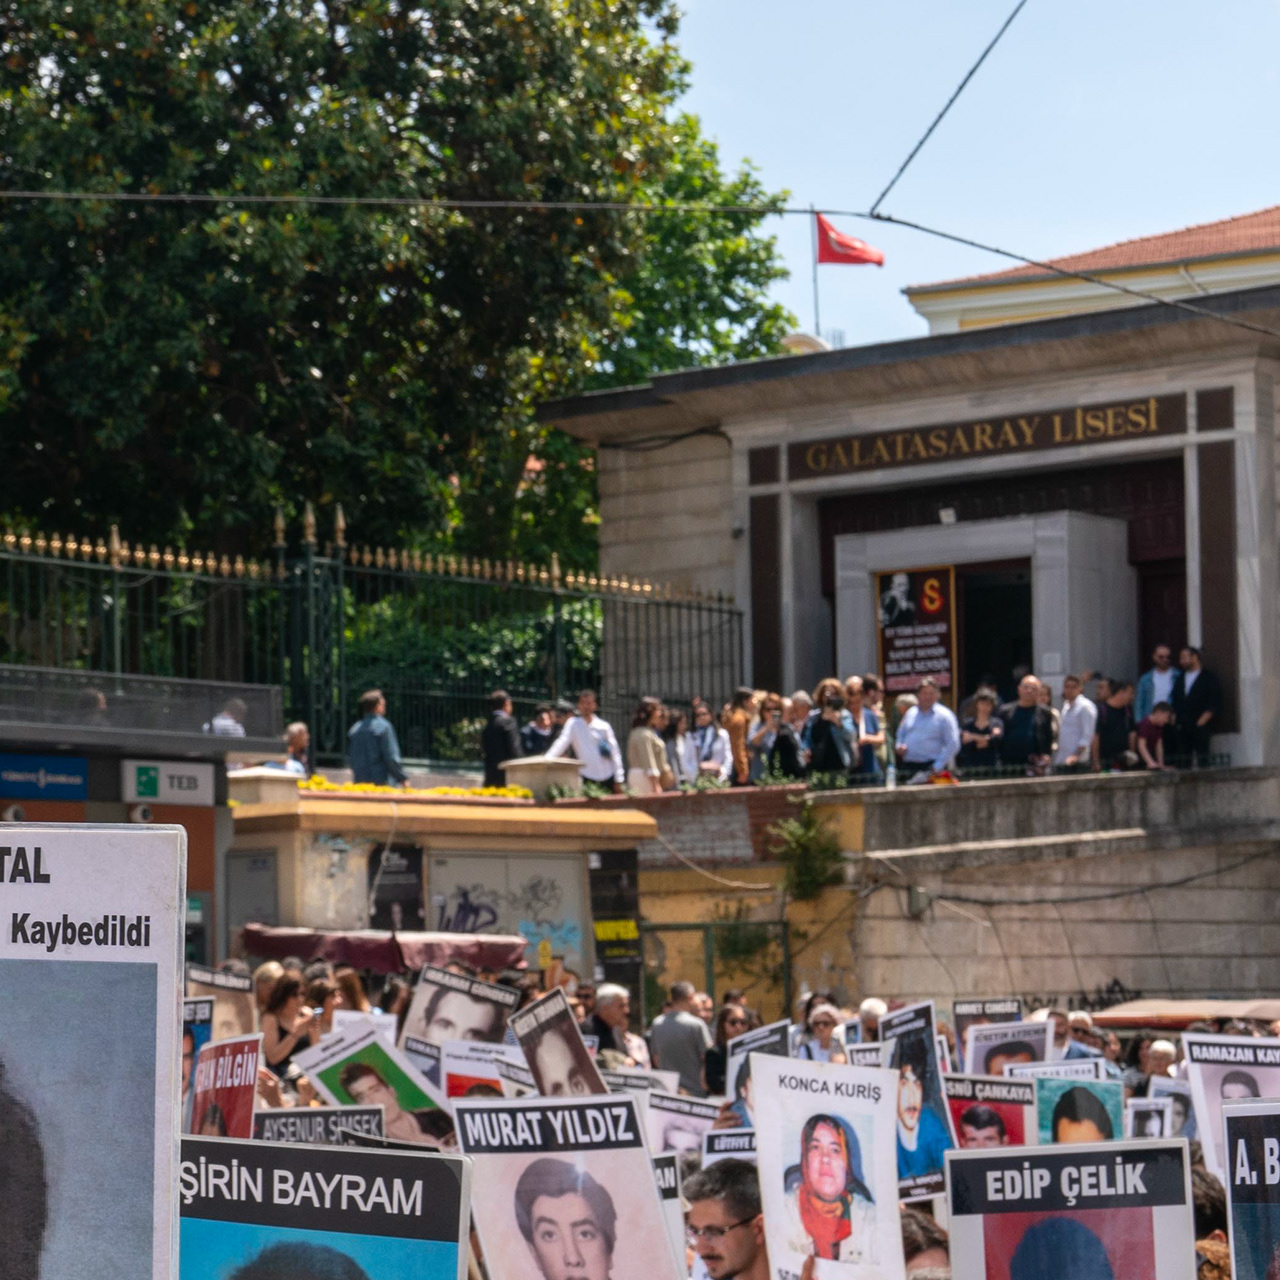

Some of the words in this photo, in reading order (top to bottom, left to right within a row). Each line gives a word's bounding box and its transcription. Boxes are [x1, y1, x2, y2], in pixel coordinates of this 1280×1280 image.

[806, 417, 1038, 472] GALATASARAY
[1053, 397, 1159, 442] LİSESİ
[167, 774, 199, 791] TEB
[11, 912, 152, 954] Kaybedildi
[217, 1046, 257, 1089] BİLGİN
[1190, 1041, 1256, 1064] RAMAZAN
[778, 1074, 830, 1095] KONCA
[834, 1081, 882, 1105] KURİŞ
[975, 1082, 1034, 1102] ÇANKAYA
[464, 1109, 547, 1147] MURAT
[548, 1106, 635, 1145] YILDIZ
[180, 1157, 264, 1205] ŞİRİN
[273, 1168, 424, 1217] BAYRAM
[986, 1158, 1052, 1202] EDİP
[1061, 1157, 1149, 1207] ÇELİK
[1235, 1151, 1258, 1186] A.
